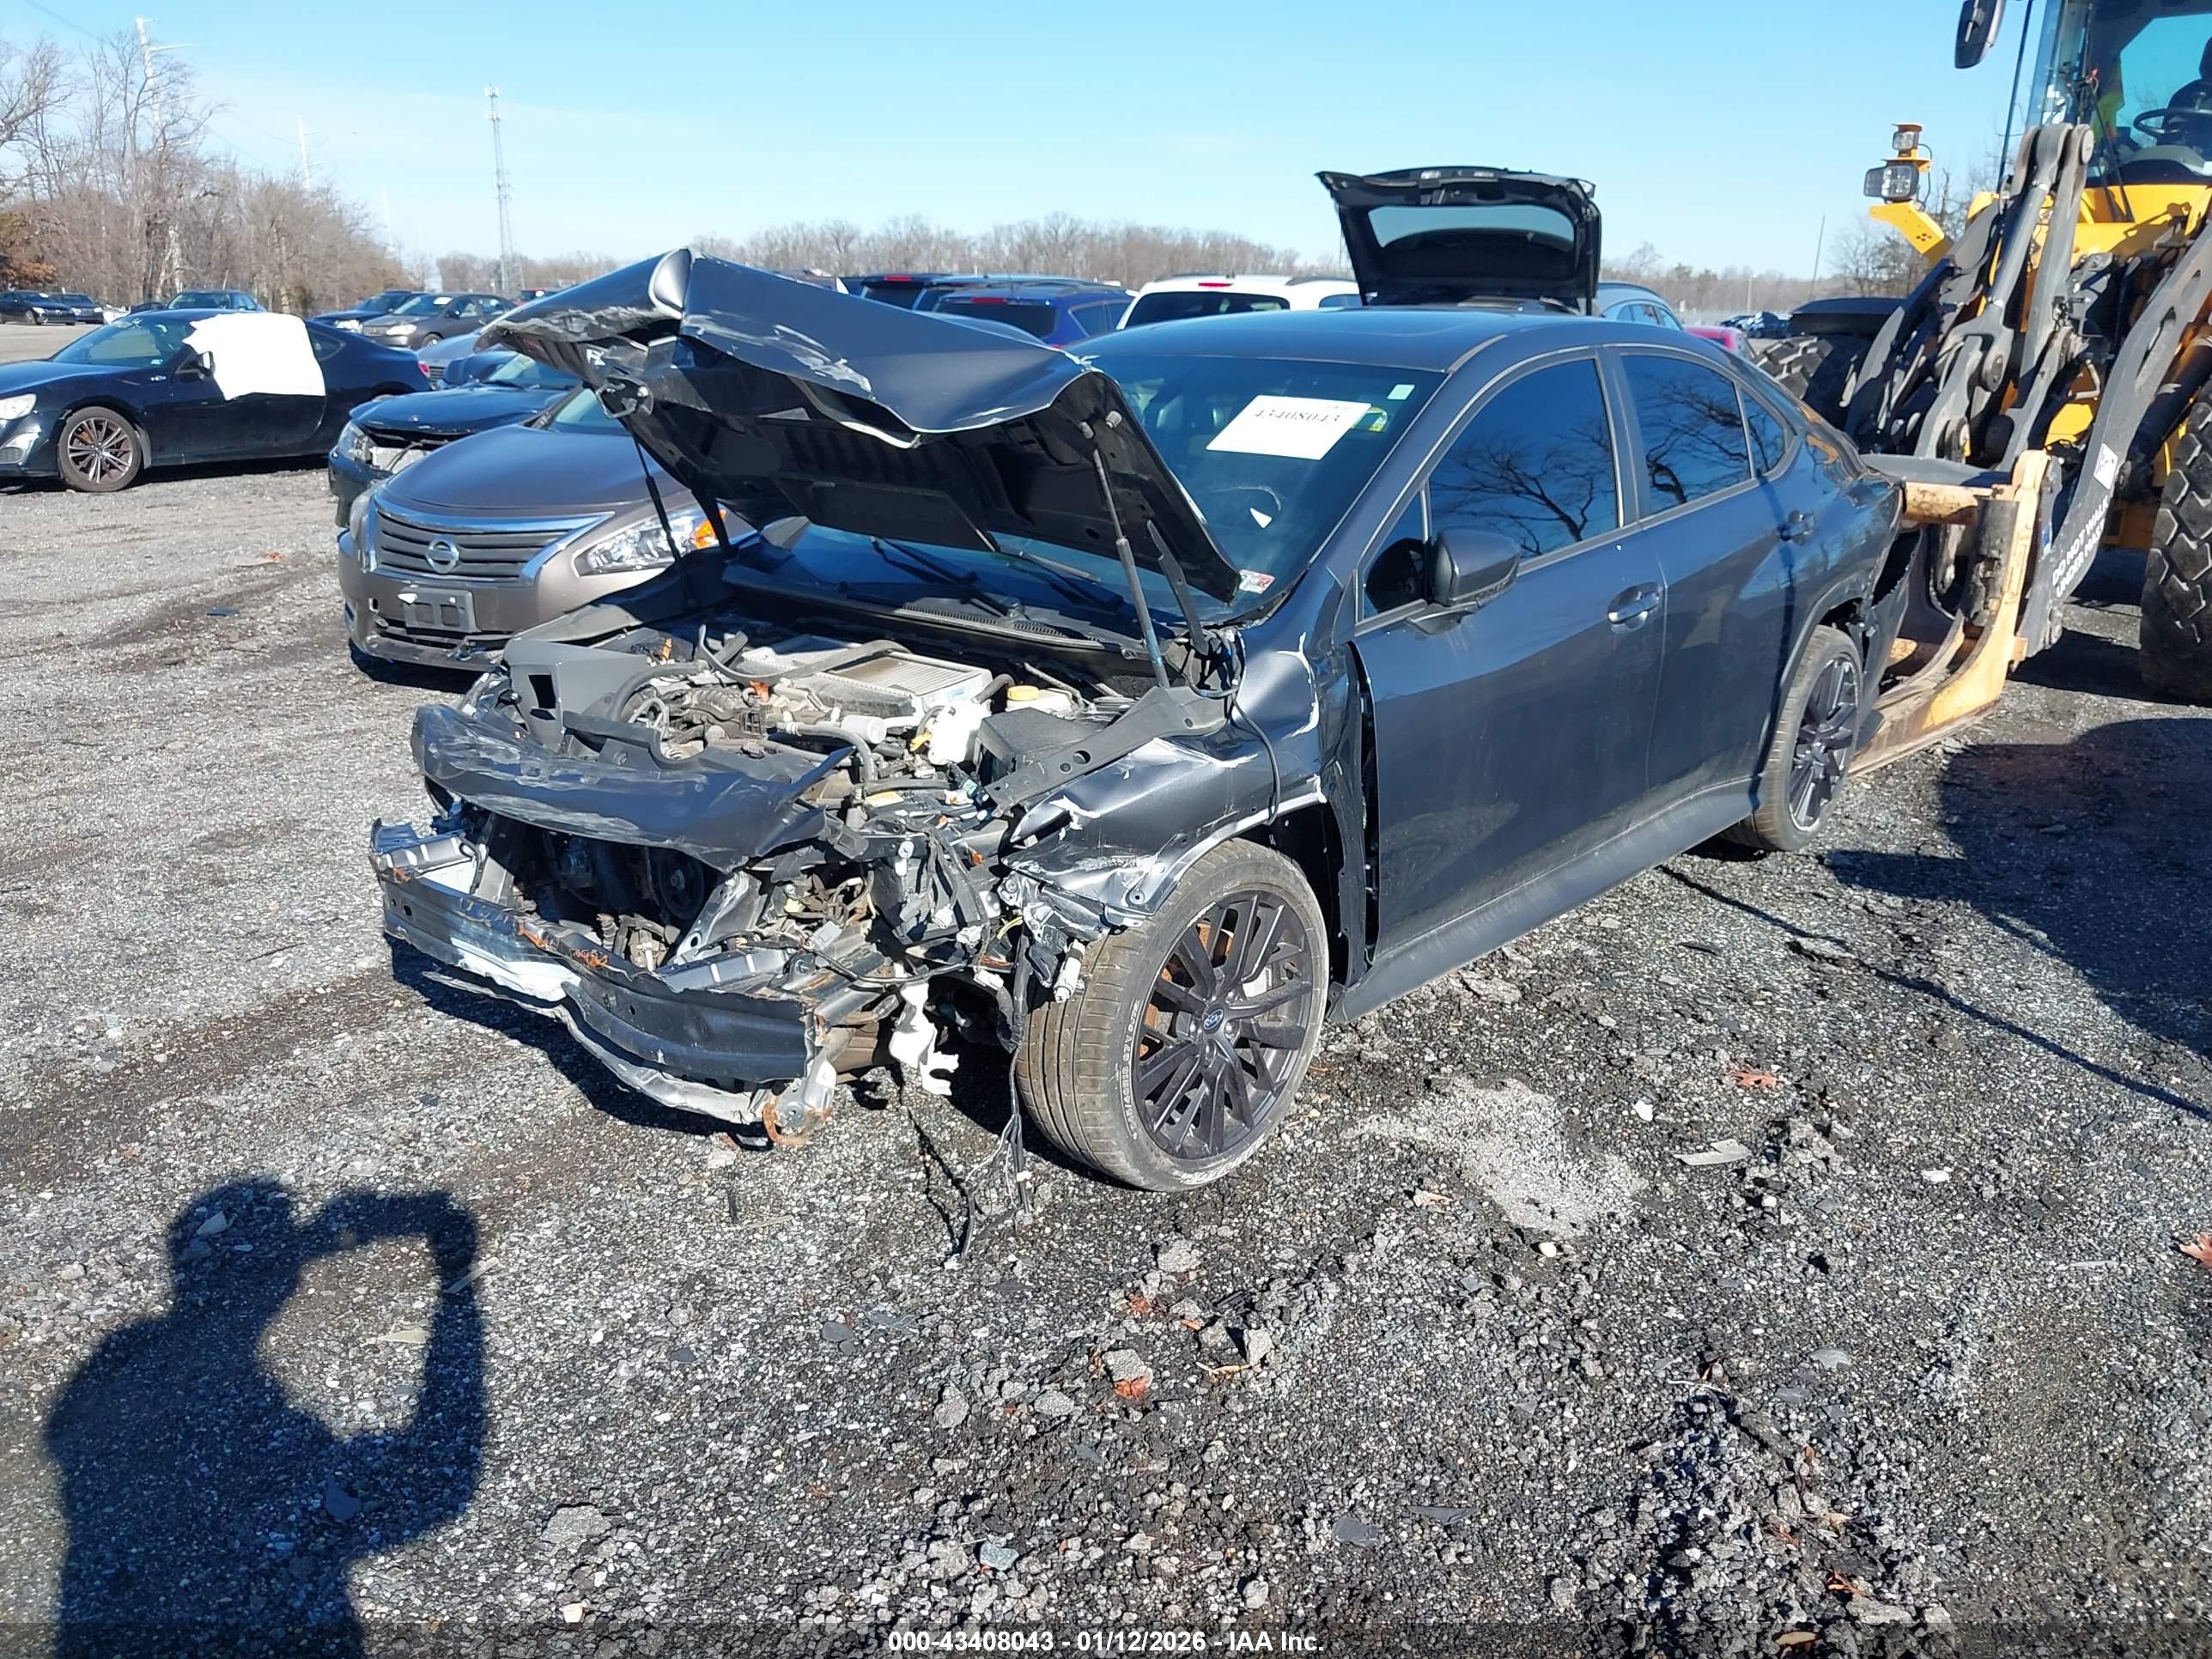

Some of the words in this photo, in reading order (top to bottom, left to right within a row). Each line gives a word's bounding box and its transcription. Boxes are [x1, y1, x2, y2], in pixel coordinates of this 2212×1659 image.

[2052, 560, 2066, 586] DO
[2066, 528, 2086, 561] NOT
[2086, 494, 2109, 534] WALK
[2056, 551, 2085, 598] UNDER
